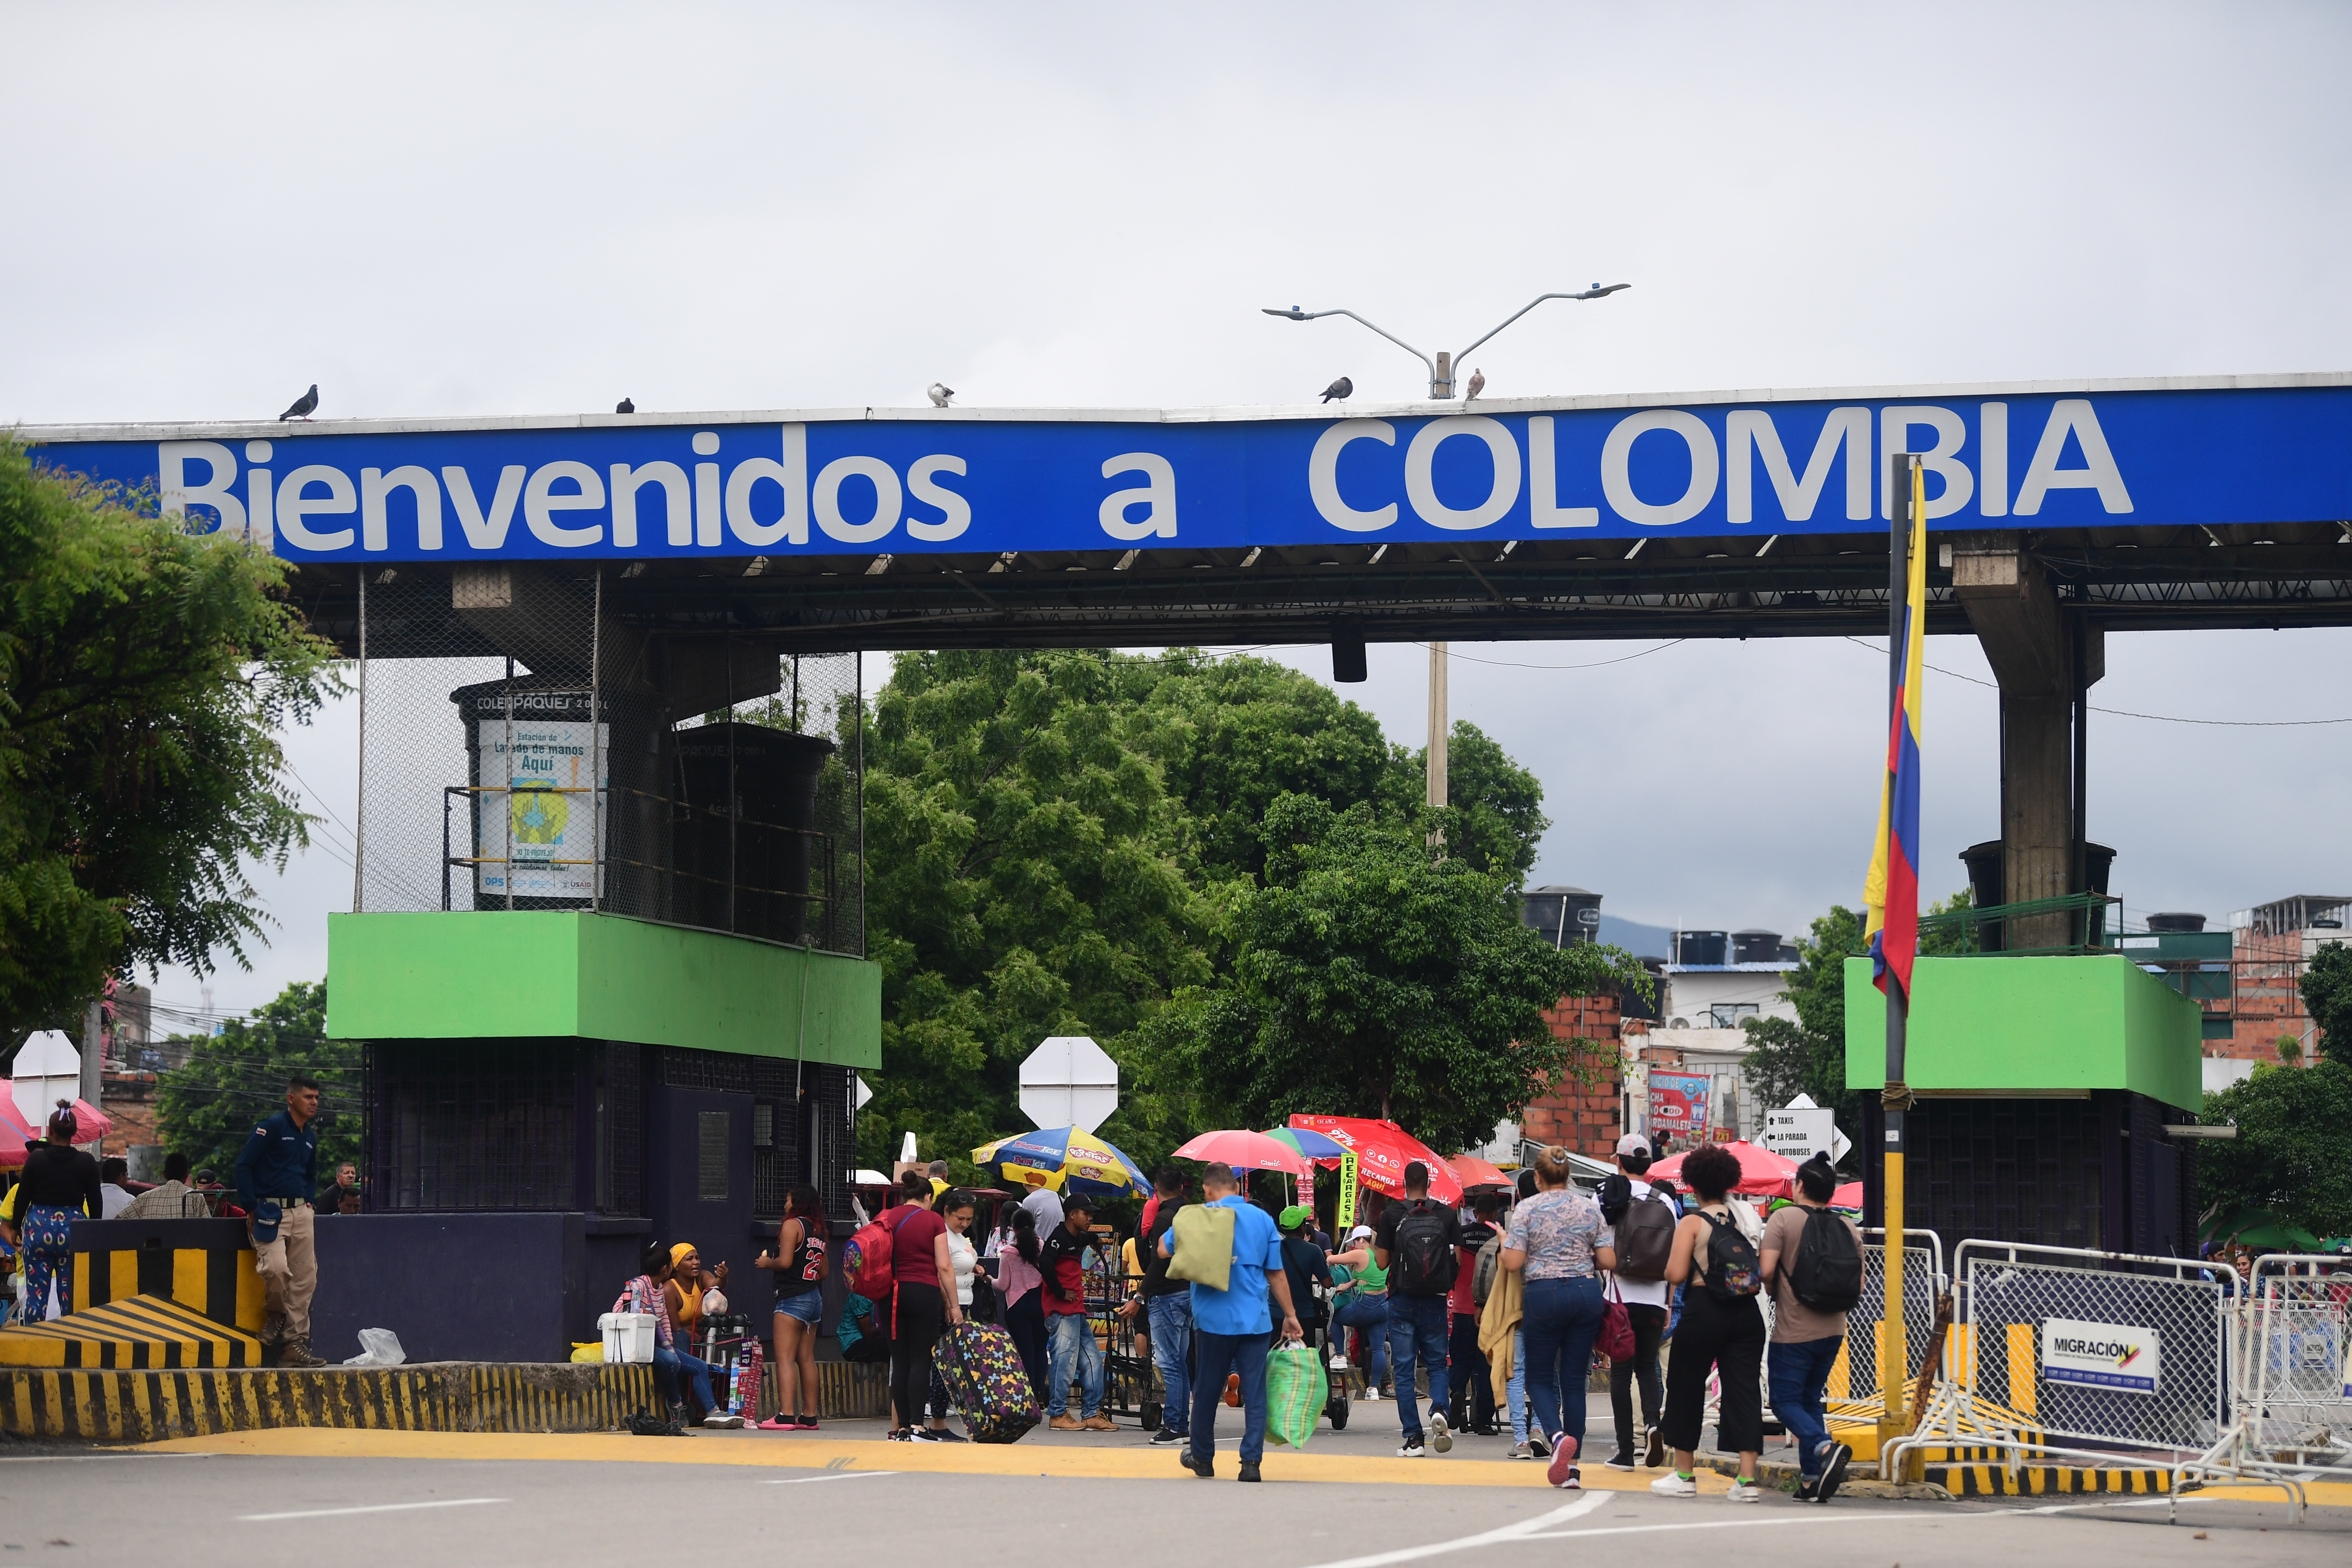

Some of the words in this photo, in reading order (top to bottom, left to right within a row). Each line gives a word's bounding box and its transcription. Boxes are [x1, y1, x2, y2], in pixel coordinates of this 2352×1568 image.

[158, 422, 971, 551] Bienvenidos
[1098, 452, 1177, 541] a
[1308, 400, 2134, 532] COLOMBIA
[477, 697, 572, 709] COLEPAQUES
[518, 732, 546, 741] Estación
[549, 733, 557, 741] de
[495, 741, 528, 754] Laado
[533, 744, 544, 754] de
[549, 746, 583, 755] manos
[522, 755, 553, 773] Aquí
[485, 877, 504, 887] OPS
[1671, 1078, 1679, 1088] DE
[1328, 1129, 1357, 1146] 99%
[1344, 1157, 1354, 1212] RECARGAS
[1361, 1167, 1395, 1187] RECARGA
[1366, 1179, 1386, 1191] AQUÍ
[2054, 1337, 2129, 1358] MIGRACIÓN
